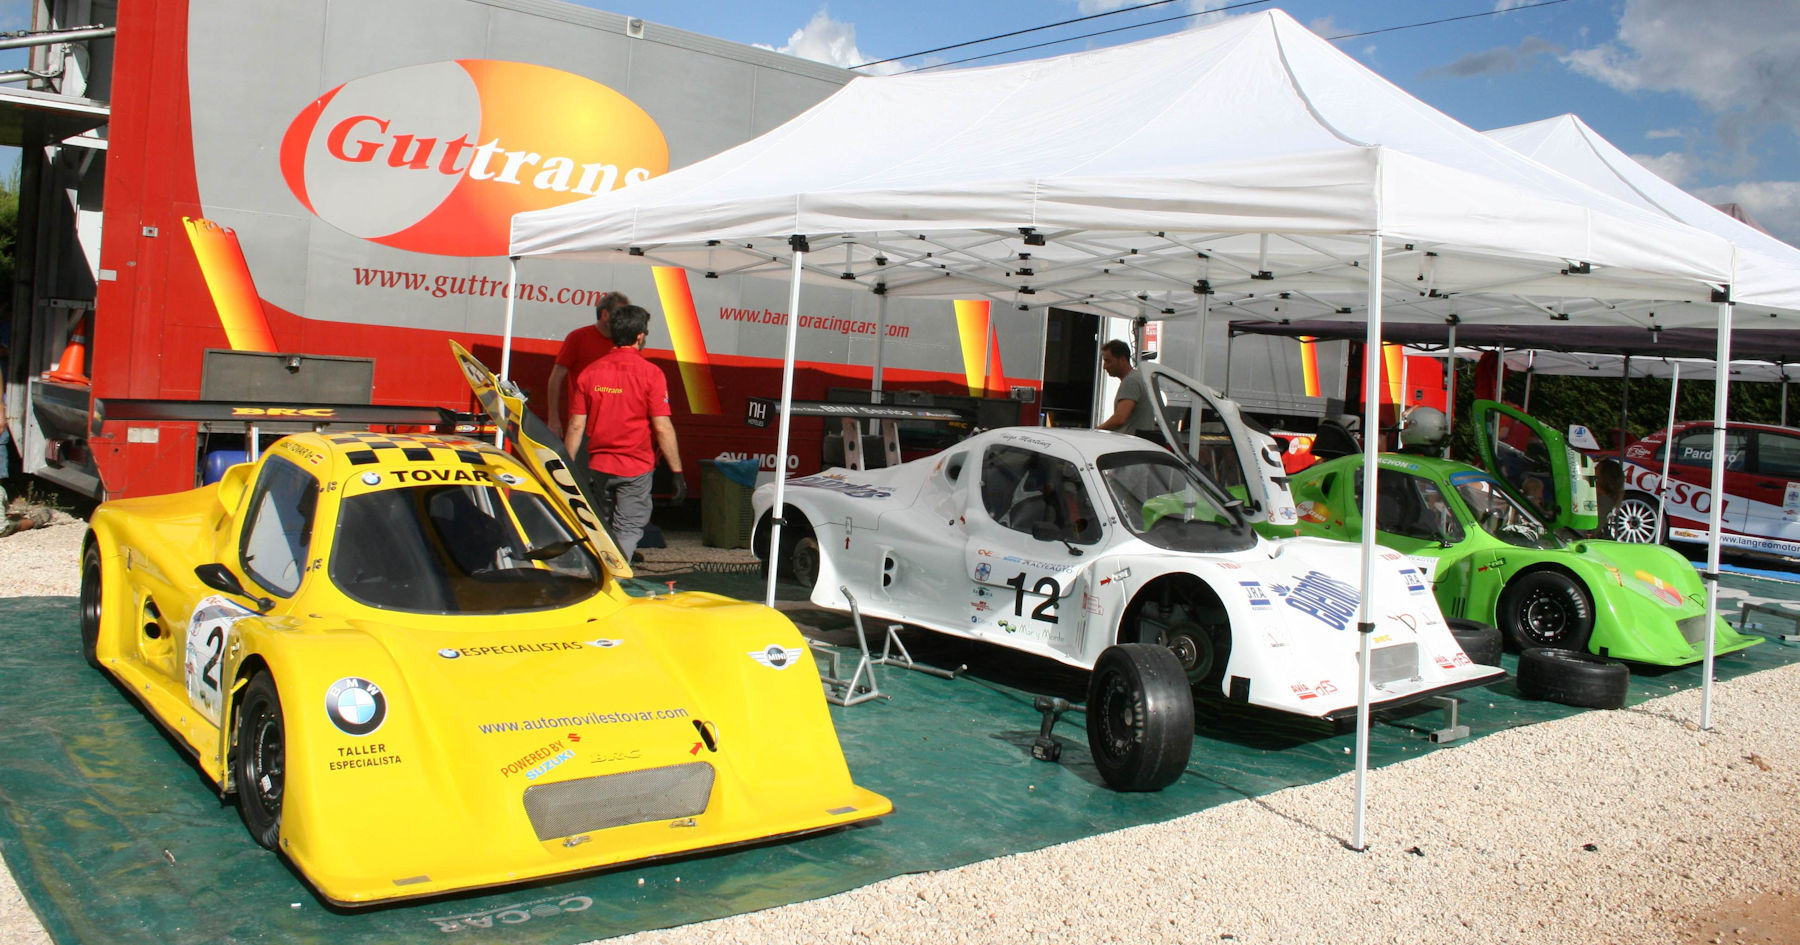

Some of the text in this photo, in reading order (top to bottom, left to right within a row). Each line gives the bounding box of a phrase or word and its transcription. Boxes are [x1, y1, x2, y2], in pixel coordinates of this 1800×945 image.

[232, 407, 336, 418] BRC
[390, 469, 493, 483] TOVAR
[1006, 572, 1061, 624] 12
[460, 641, 583, 657] ESPECIALISTAS
[478, 706, 689, 735] www.automovilestovar.com
[338, 743, 386, 757] TALLER
[329, 755, 402, 771] ESPECIALISTA
[500, 740, 565, 779] POWERED BY
[525, 749, 576, 781] SUZUKI
